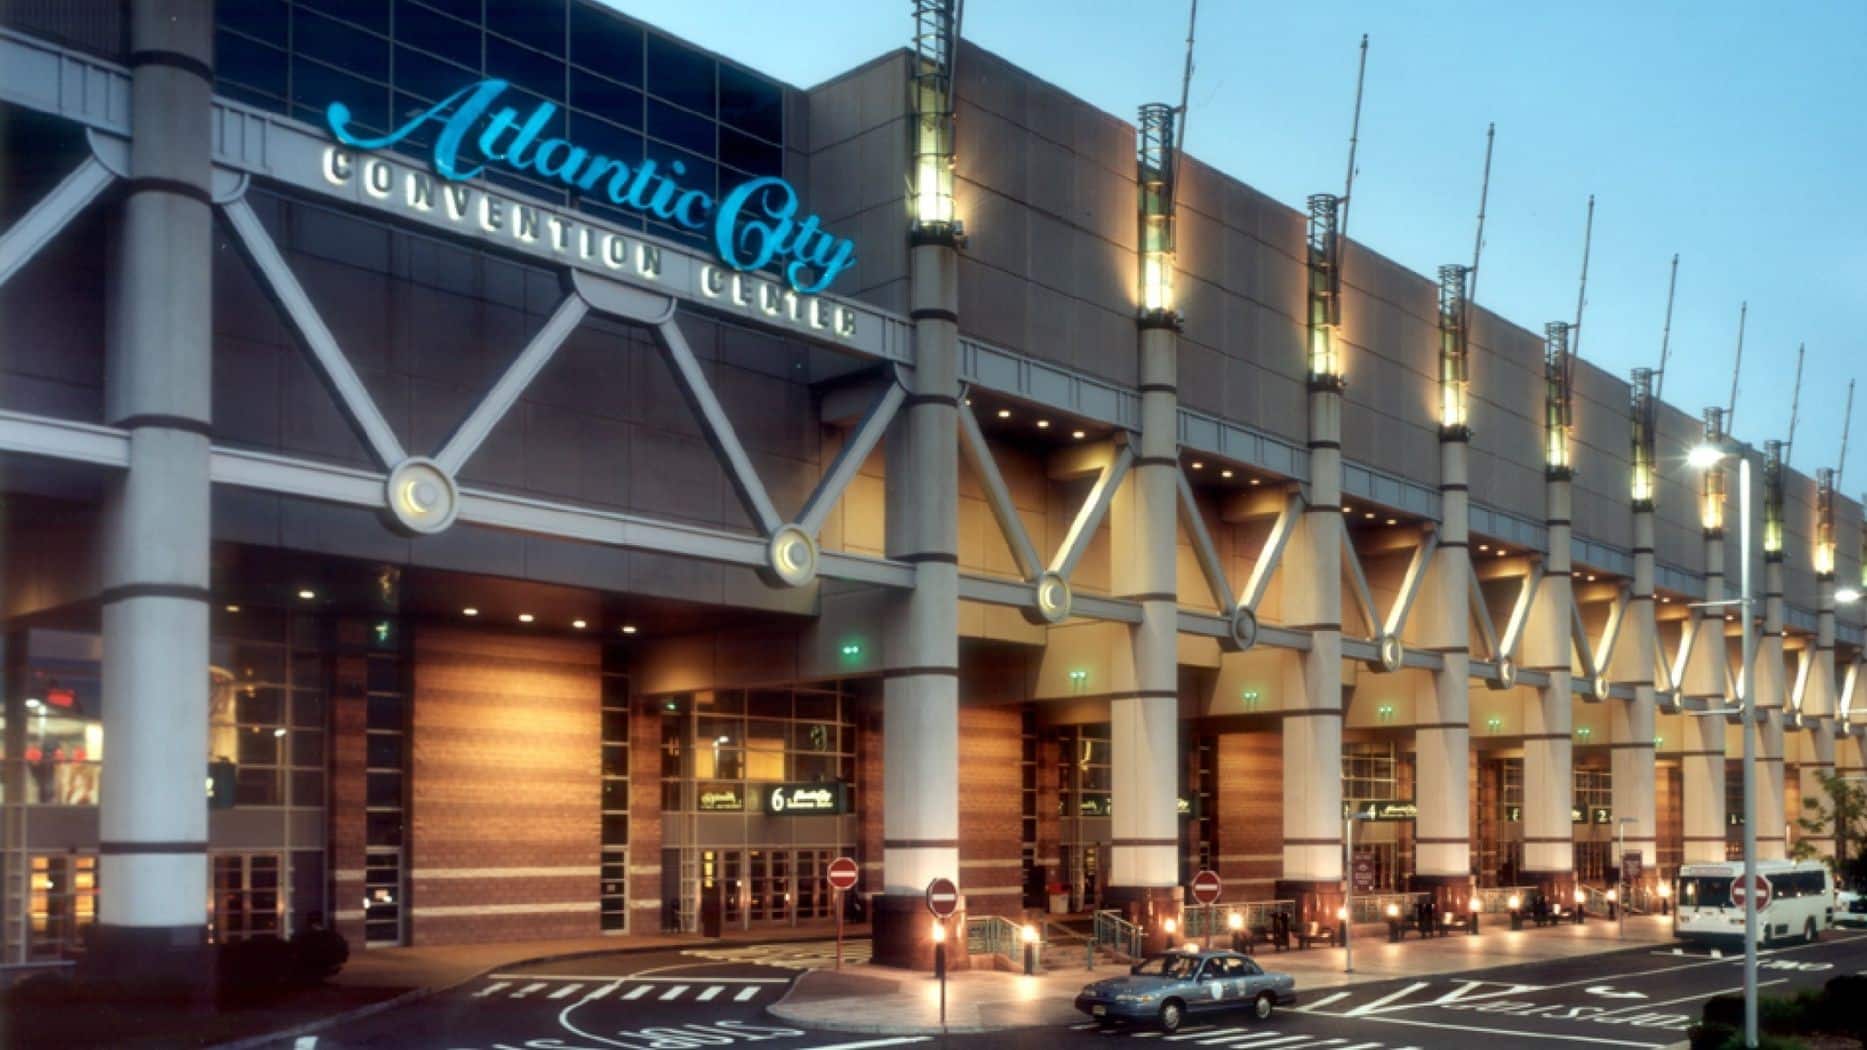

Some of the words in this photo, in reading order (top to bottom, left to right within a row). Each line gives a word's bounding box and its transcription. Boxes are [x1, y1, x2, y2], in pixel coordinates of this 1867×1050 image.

[322, 145, 664, 279] CONVENTION
[701, 262, 858, 337] CENTER
[327, 79, 714, 229] Atlantic
[715, 176, 857, 294] City
[771, 787, 785, 811] 6
